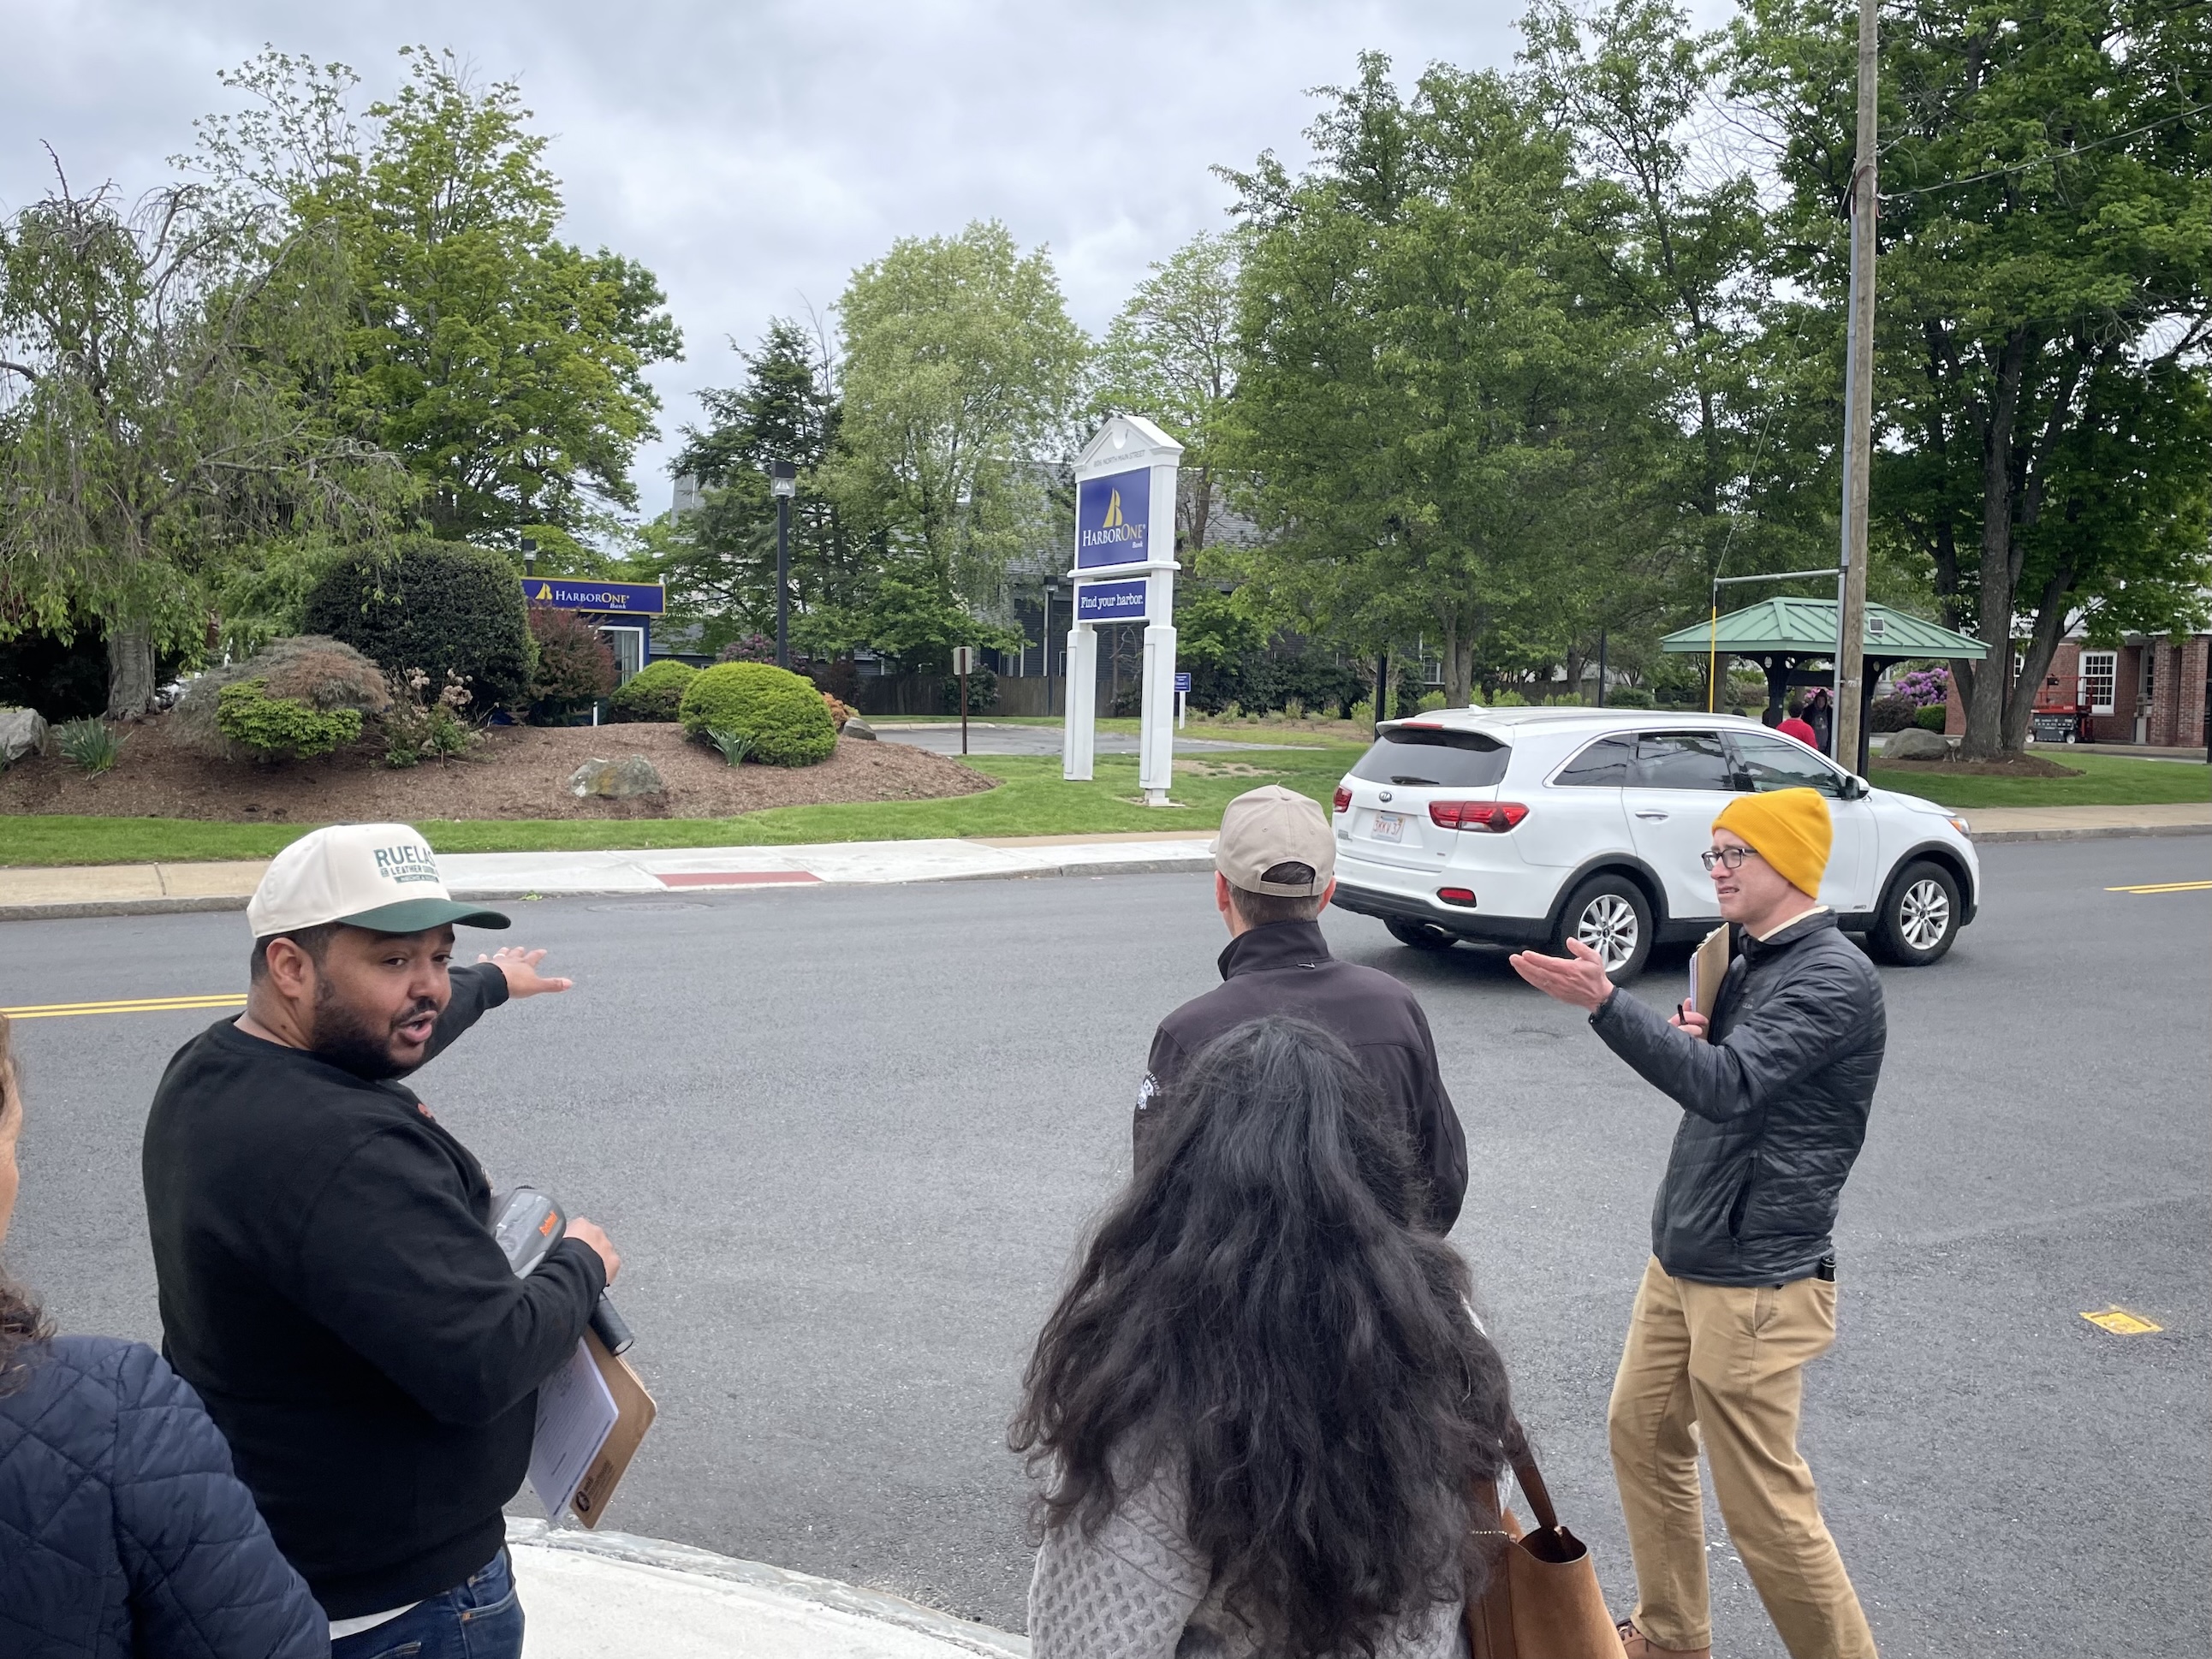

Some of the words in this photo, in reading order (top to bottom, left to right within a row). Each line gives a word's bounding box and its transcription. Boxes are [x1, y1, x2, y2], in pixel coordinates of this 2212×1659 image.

[1103, 456, 1117, 465] NORTH
[1118, 454, 1128, 463] MAIN
[1129, 449, 1145, 460] STREET
[1080, 595, 1097, 609] Find
[1097, 596, 1115, 610] your
[1115, 592, 1144, 606] harbor.
[373, 845, 436, 867] RUELAS
[390, 865, 422, 875] LEATHER
